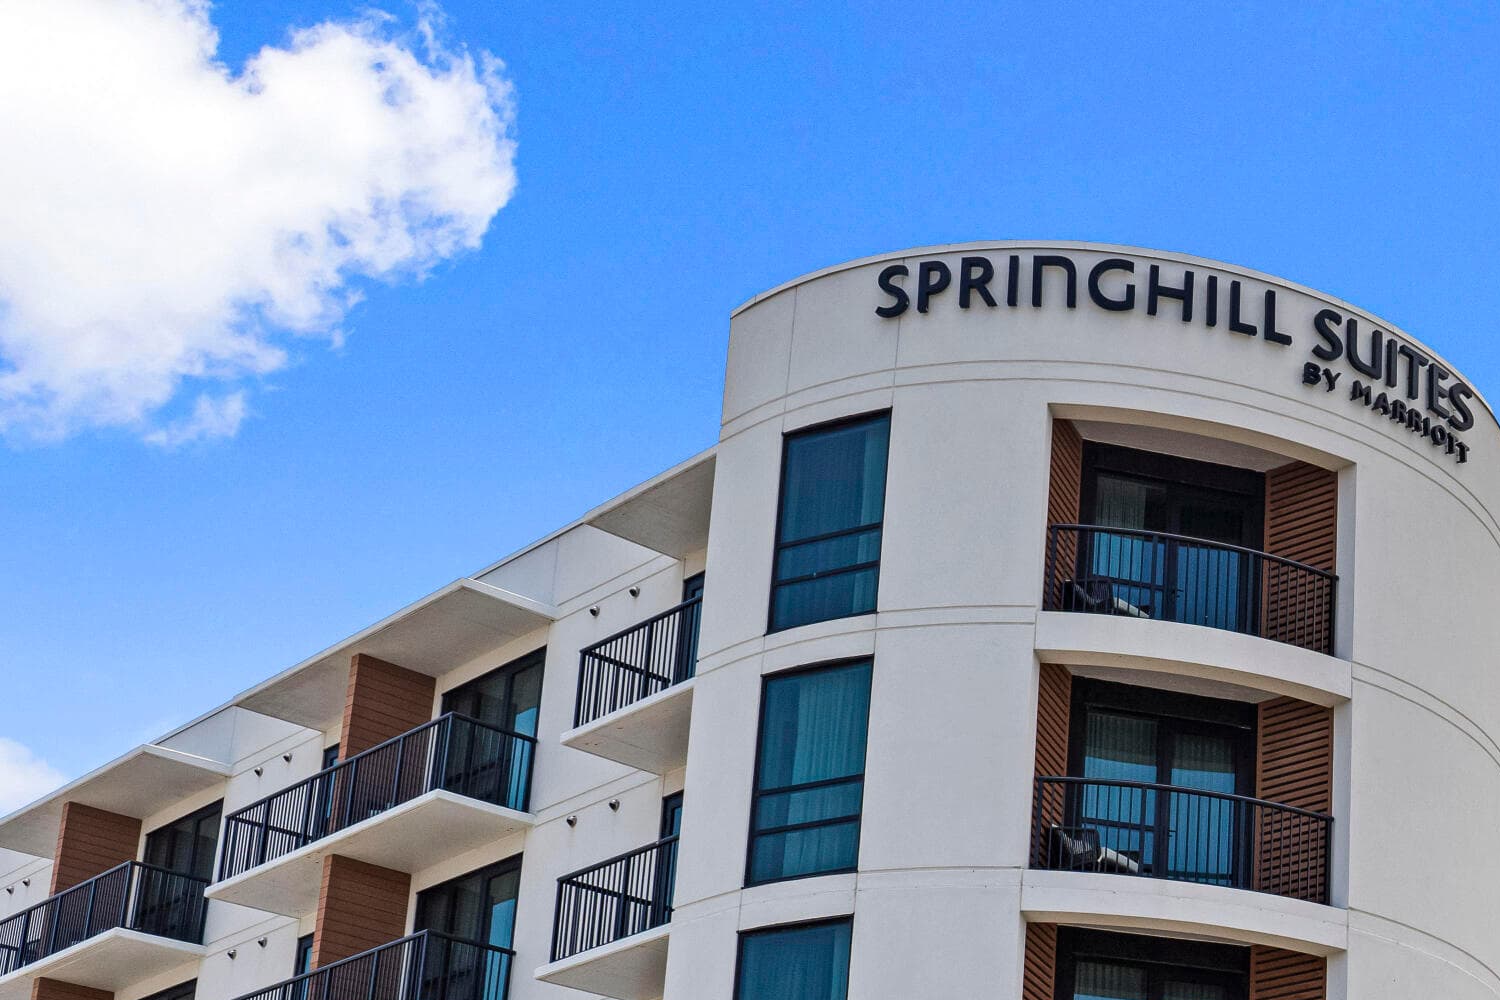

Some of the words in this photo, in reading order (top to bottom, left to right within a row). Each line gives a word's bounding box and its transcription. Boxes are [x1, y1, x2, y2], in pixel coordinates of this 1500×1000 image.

[875, 255, 1293, 346] SPRINGHILL
[1312, 309, 1475, 432] SUITES
[1303, 362, 1341, 393] BY
[1350, 380, 1471, 463] MARRIOTT
